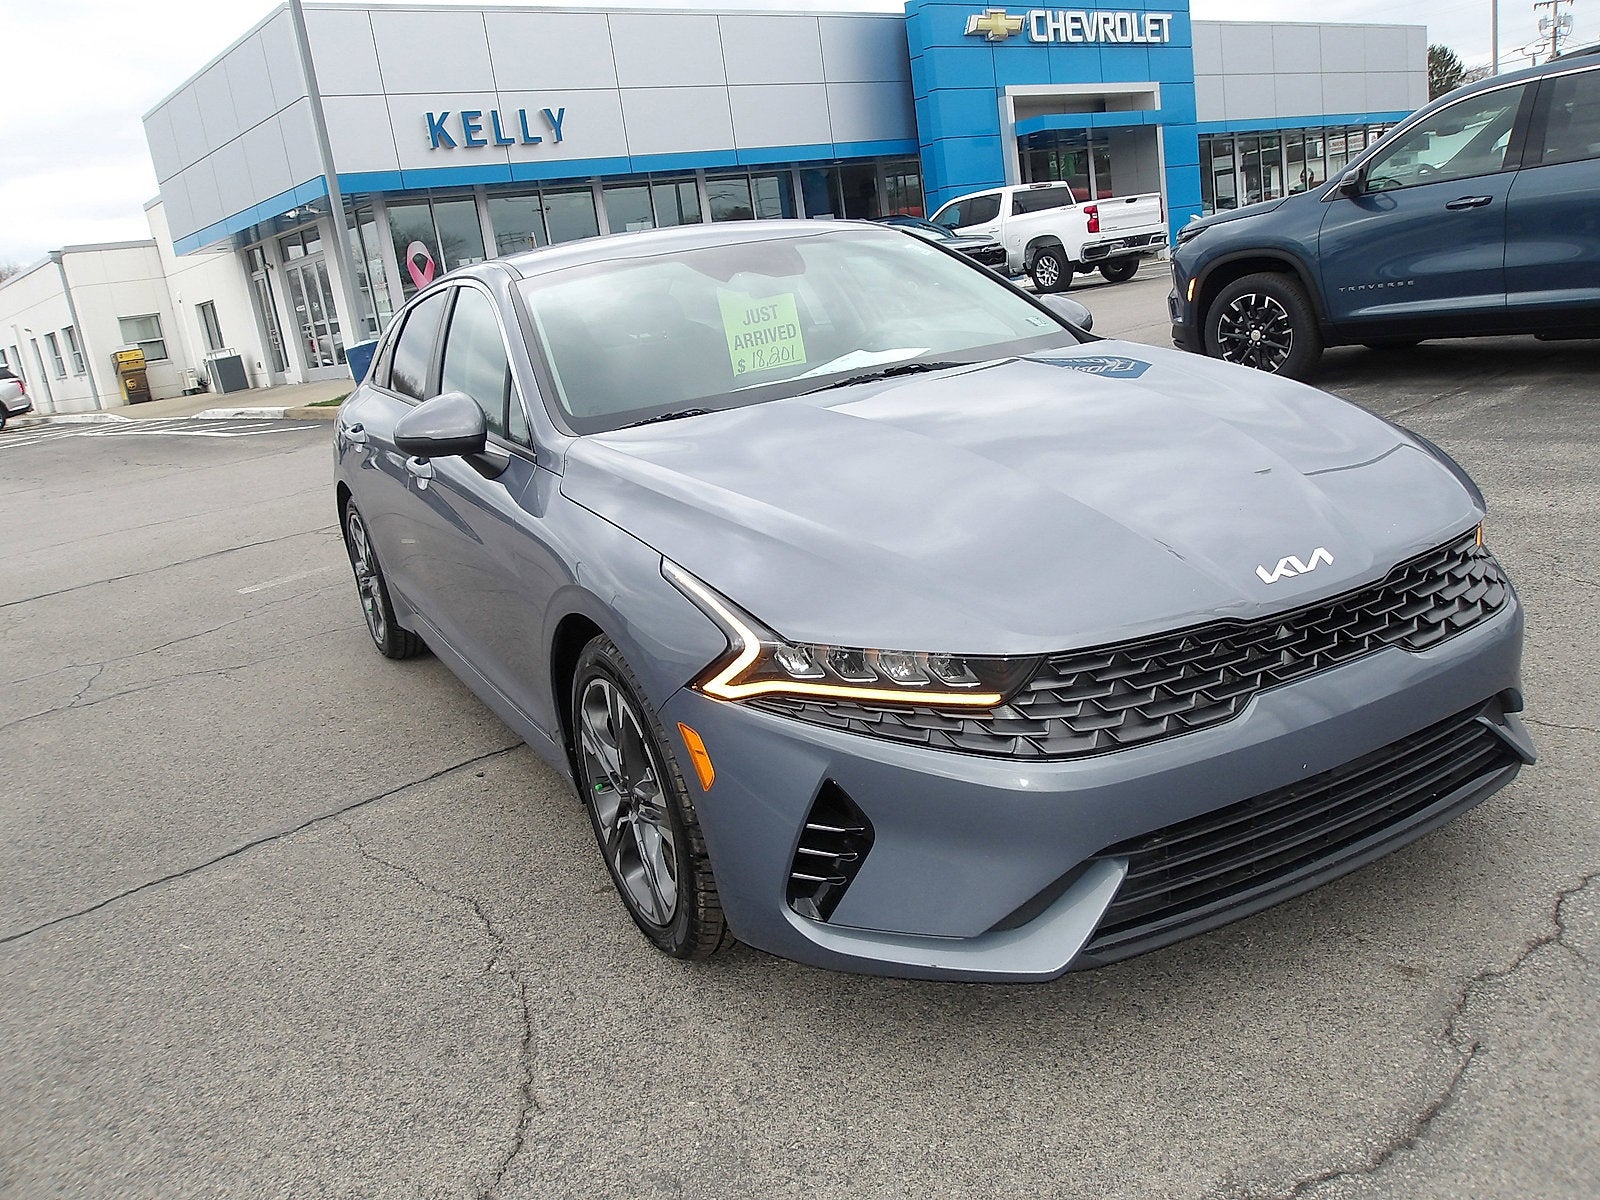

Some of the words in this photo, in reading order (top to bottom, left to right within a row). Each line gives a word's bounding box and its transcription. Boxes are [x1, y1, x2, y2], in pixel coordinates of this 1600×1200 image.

[1027, 9, 1173, 43] CHEVROLET
[424, 107, 565, 150] KELLY
[1338, 280, 1415, 292] TRAVERSE
[742, 304, 778, 326] JUST
[734, 323, 797, 350] ARRIVED
[737, 358, 746, 373] $
[1254, 546, 1335, 585] KIA
